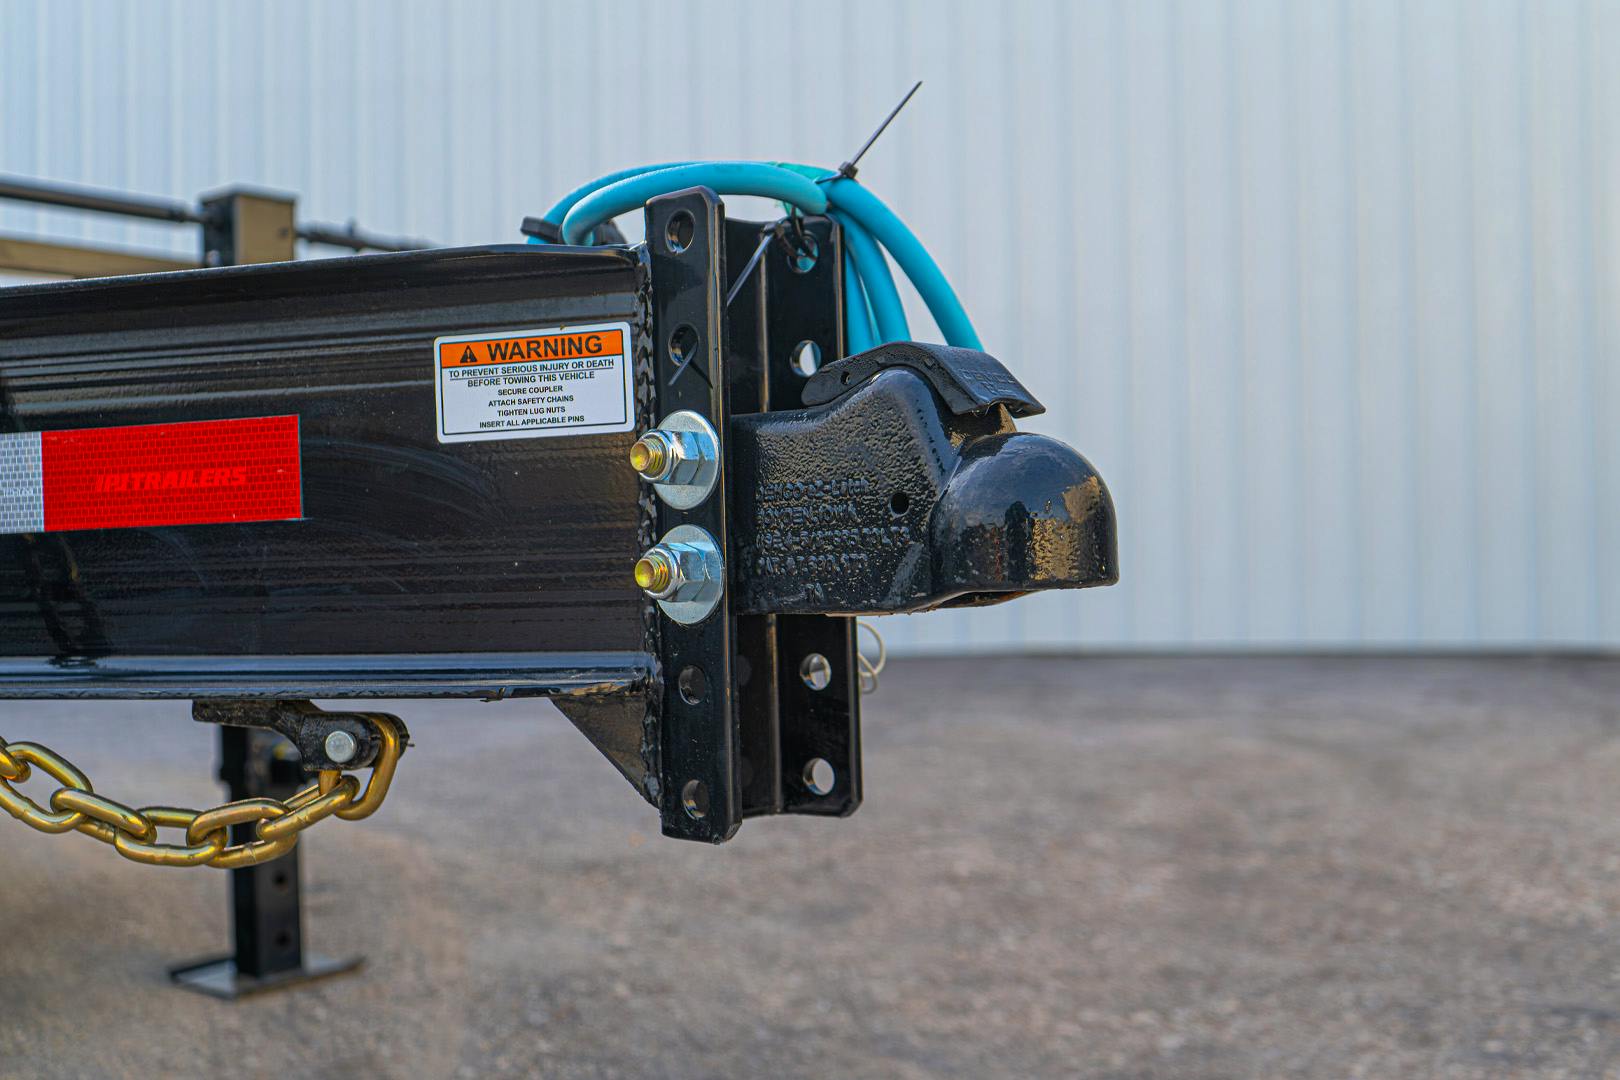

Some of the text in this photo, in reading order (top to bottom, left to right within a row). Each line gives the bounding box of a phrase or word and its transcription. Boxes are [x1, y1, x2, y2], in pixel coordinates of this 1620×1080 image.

[486, 335, 602, 361] WARNING
[449, 358, 614, 378] TO PREVENT SERIOUS INJURY OR DEATH
[467, 371, 595, 387] BEFORE TOWING THIS VEHICLE
[497, 385, 563, 396] SECURE COUPLER
[488, 395, 574, 407] ATTACH SAFETY CHAINS
[497, 405, 566, 417] TIGHTEN LUG NUTS
[479, 415, 585, 428] INSERT ALL APPLICABLE PINS
